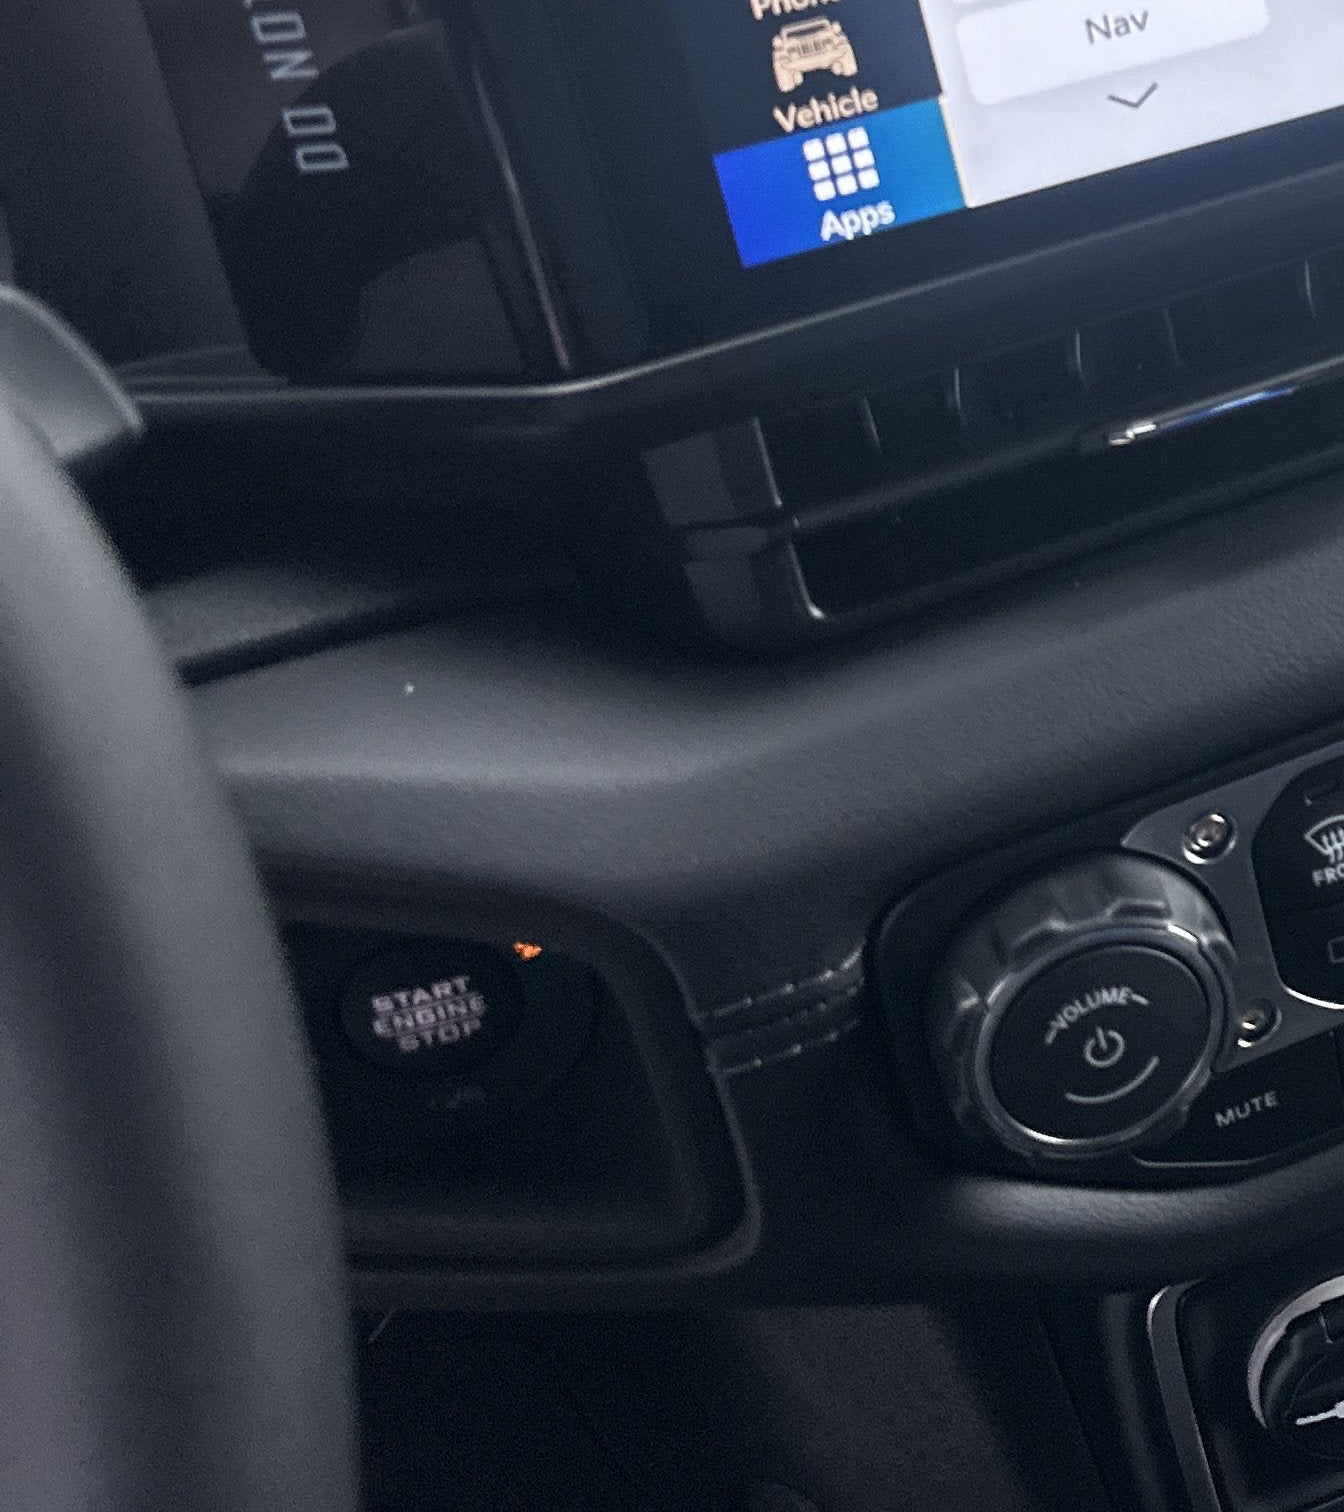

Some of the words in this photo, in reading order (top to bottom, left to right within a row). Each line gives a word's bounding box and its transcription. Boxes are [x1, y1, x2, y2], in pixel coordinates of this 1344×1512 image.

[1084, 9, 1150, 46] Nav
[772, 86, 879, 133] Vehicle
[281, 103, 349, 173] DO
[819, 200, 896, 242] Apps
[371, 975, 471, 1012] START
[1050, 985, 1134, 1029] VOLUME
[372, 991, 488, 1040] ENGINE
[400, 1018, 481, 1052] STOP
[1213, 1090, 1280, 1128] MUTE
